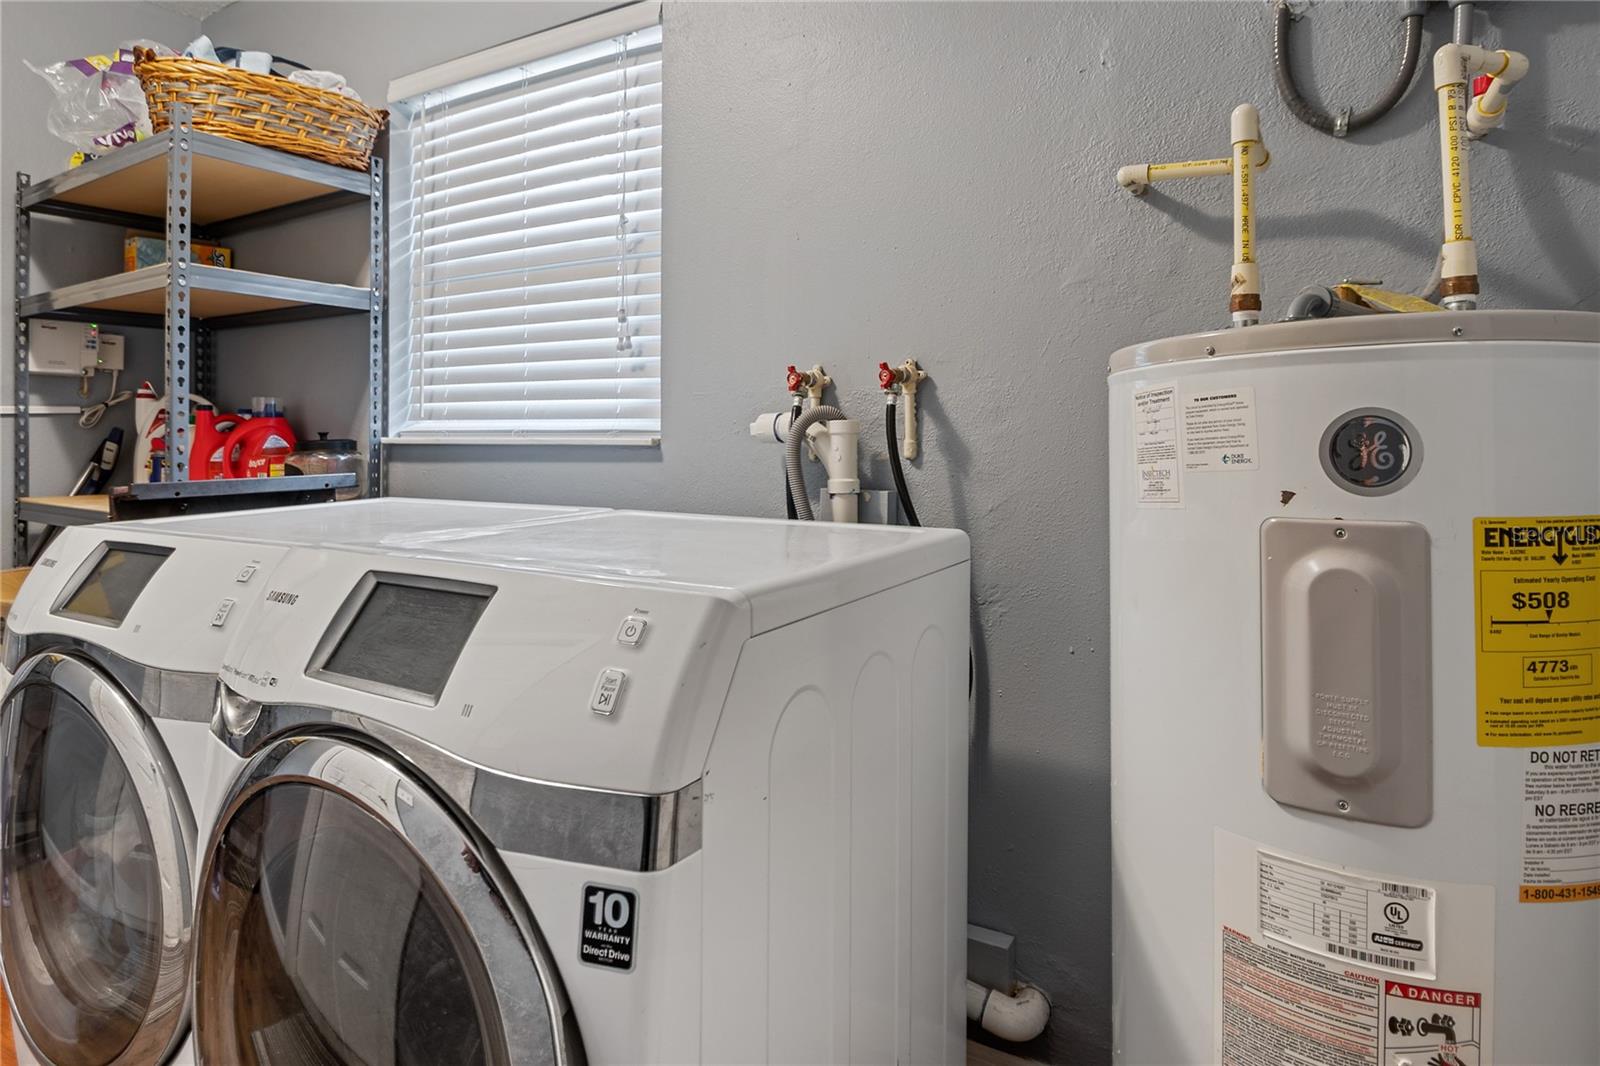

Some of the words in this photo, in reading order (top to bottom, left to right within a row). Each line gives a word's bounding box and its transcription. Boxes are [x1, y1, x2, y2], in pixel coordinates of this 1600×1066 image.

[1449, 115, 1457, 131] PSI
[1450, 135, 1458, 152] 400
[1452, 156, 1460, 177] 4120
[1453, 182, 1462, 203] CPVC
[1241, 215, 1249, 234] MADE
[1455, 223, 1463, 241] SDR
[1242, 240, 1250, 249] IN
[1514, 576, 1542, 584] Estimated
[1544, 575, 1560, 584] Yearly
[1561, 575, 1585, 584] Operating
[266, 590, 299, 606] SAMSUNG
[1512, 591, 1570, 612] $508
[1527, 659, 1569, 674] 4773
[604, 676, 618, 684] Start
[600, 685, 616, 693] Pause
[1530, 751, 1549, 763] DO
[1553, 751, 1577, 763] NOT
[1535, 804, 1555, 817] NO
[1560, 802, 1600, 816] REGRE
[588, 890, 630, 929] 10
[1389, 906, 1404, 921] UL
[584, 929, 630, 945] WARRANTY
[598, 926, 618, 934] YEAR
[583, 944, 607, 957] Direct
[608, 949, 630, 962] Drive
[1266, 944, 1289, 957] ELECTRIC
[1289, 953, 1306, 963] WATER
[1306, 959, 1326, 968] HEATER
[1344, 970, 1380, 984] CAUTION
[1408, 988, 1475, 1006] DANGER
[1440, 1044, 1459, 1053] HOT
